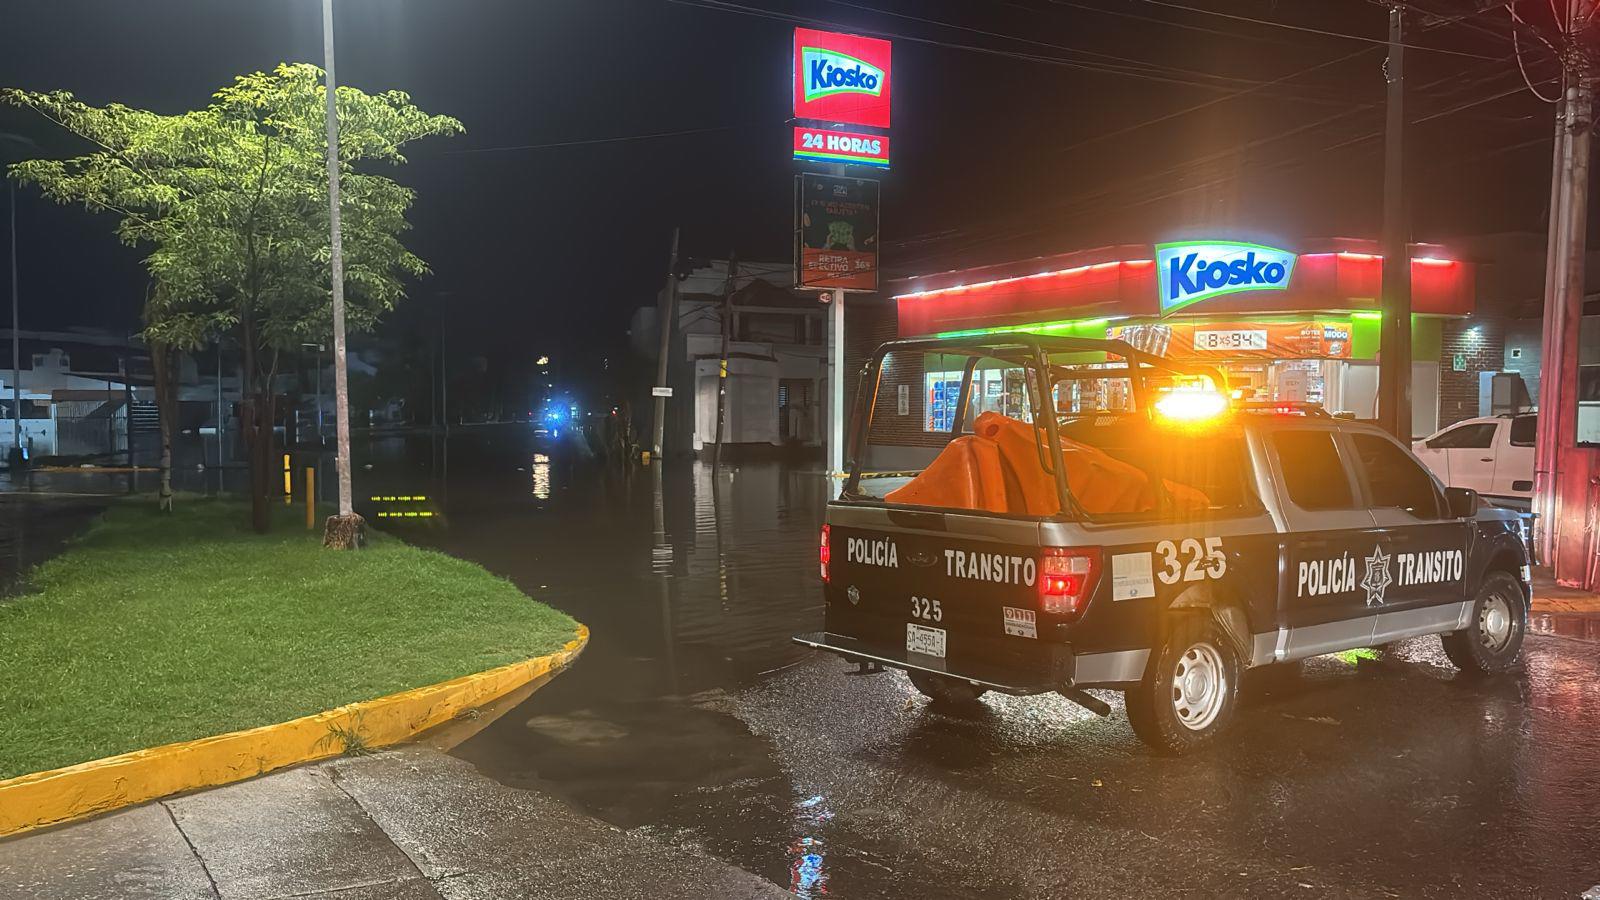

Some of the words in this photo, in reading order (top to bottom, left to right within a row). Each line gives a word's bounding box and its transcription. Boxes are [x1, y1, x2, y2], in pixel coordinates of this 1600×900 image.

[811, 59, 878, 89] Kiosko
[802, 133, 823, 148] 24
[827, 135, 881, 155] HORAS
[1170, 252, 1285, 300] Kiosko
[847, 537, 898, 568] POLICÍA
[945, 549, 1036, 586] TRANSITO
[1155, 536, 1227, 585] 325
[1297, 550, 1356, 598] POLICÍA
[1397, 549, 1463, 586] TRANSITO
[911, 596, 942, 622] 325
[1005, 609, 1035, 622] 911
